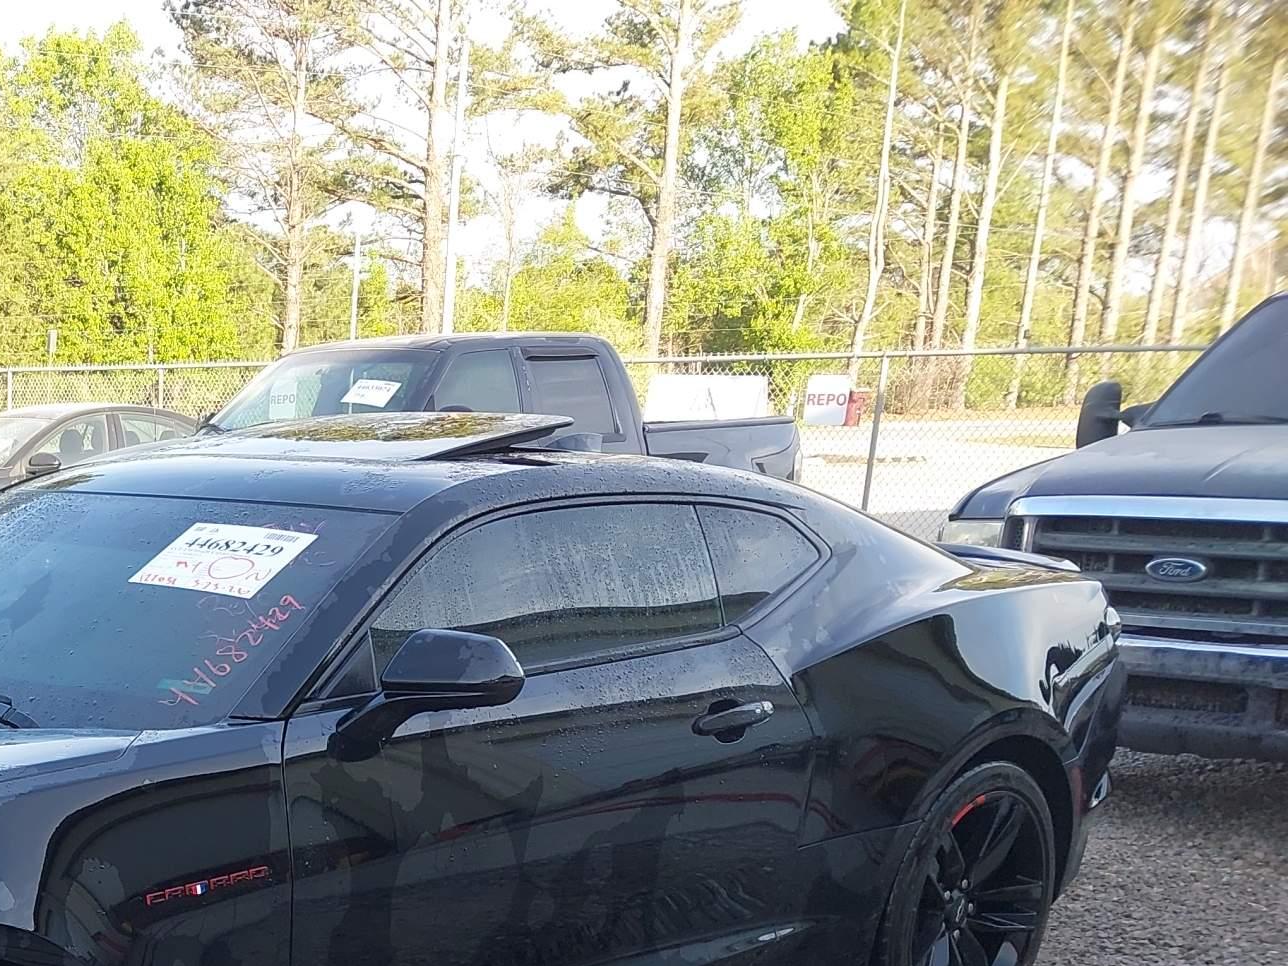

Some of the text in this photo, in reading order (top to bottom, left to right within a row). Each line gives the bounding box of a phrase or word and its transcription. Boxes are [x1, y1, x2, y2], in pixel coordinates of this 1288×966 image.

[270, 393, 296, 404] REPO
[806, 393, 847, 406] REPO
[185, 537, 284, 557] 44682429
[1159, 561, 1192, 576] Ford
[157, 594, 306, 706] 44682429
